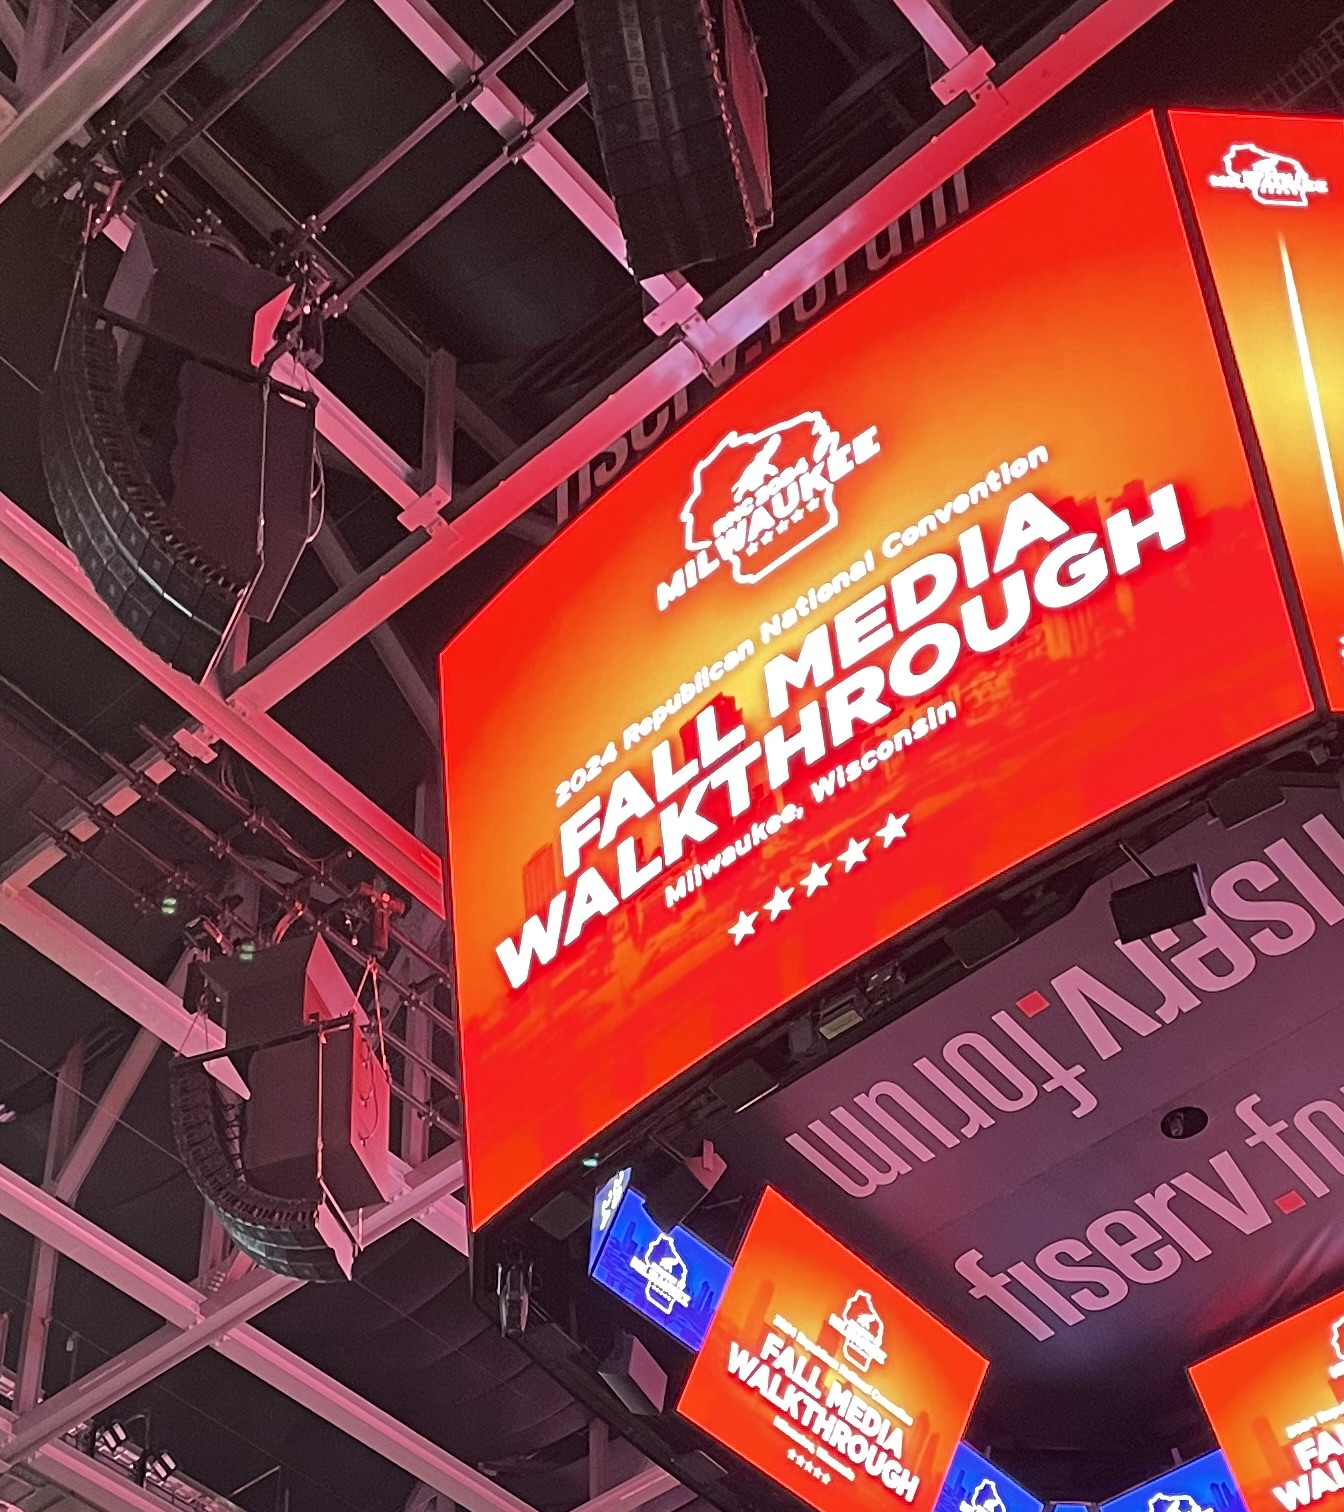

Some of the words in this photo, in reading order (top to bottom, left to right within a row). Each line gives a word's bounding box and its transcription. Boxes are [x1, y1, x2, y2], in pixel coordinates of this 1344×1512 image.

[657, 426, 881, 612] MILWAUKEE
[555, 741, 618, 808] 2024
[623, 638, 755, 751] Republican
[759, 549, 875, 644] National
[881, 445, 1049, 560] Convention
[559, 705, 747, 878] FALL
[764, 492, 1070, 719] MEDIA
[495, 483, 1186, 990] WALKTHROUGH
[665, 804, 805, 908] Milwaukee,
[810, 700, 957, 803] Wisconsin
[728, 1341, 920, 1503] WALKTHROUGH
[760, 1333, 821, 1399] FALL
[825, 1380, 903, 1459] MEDIA
